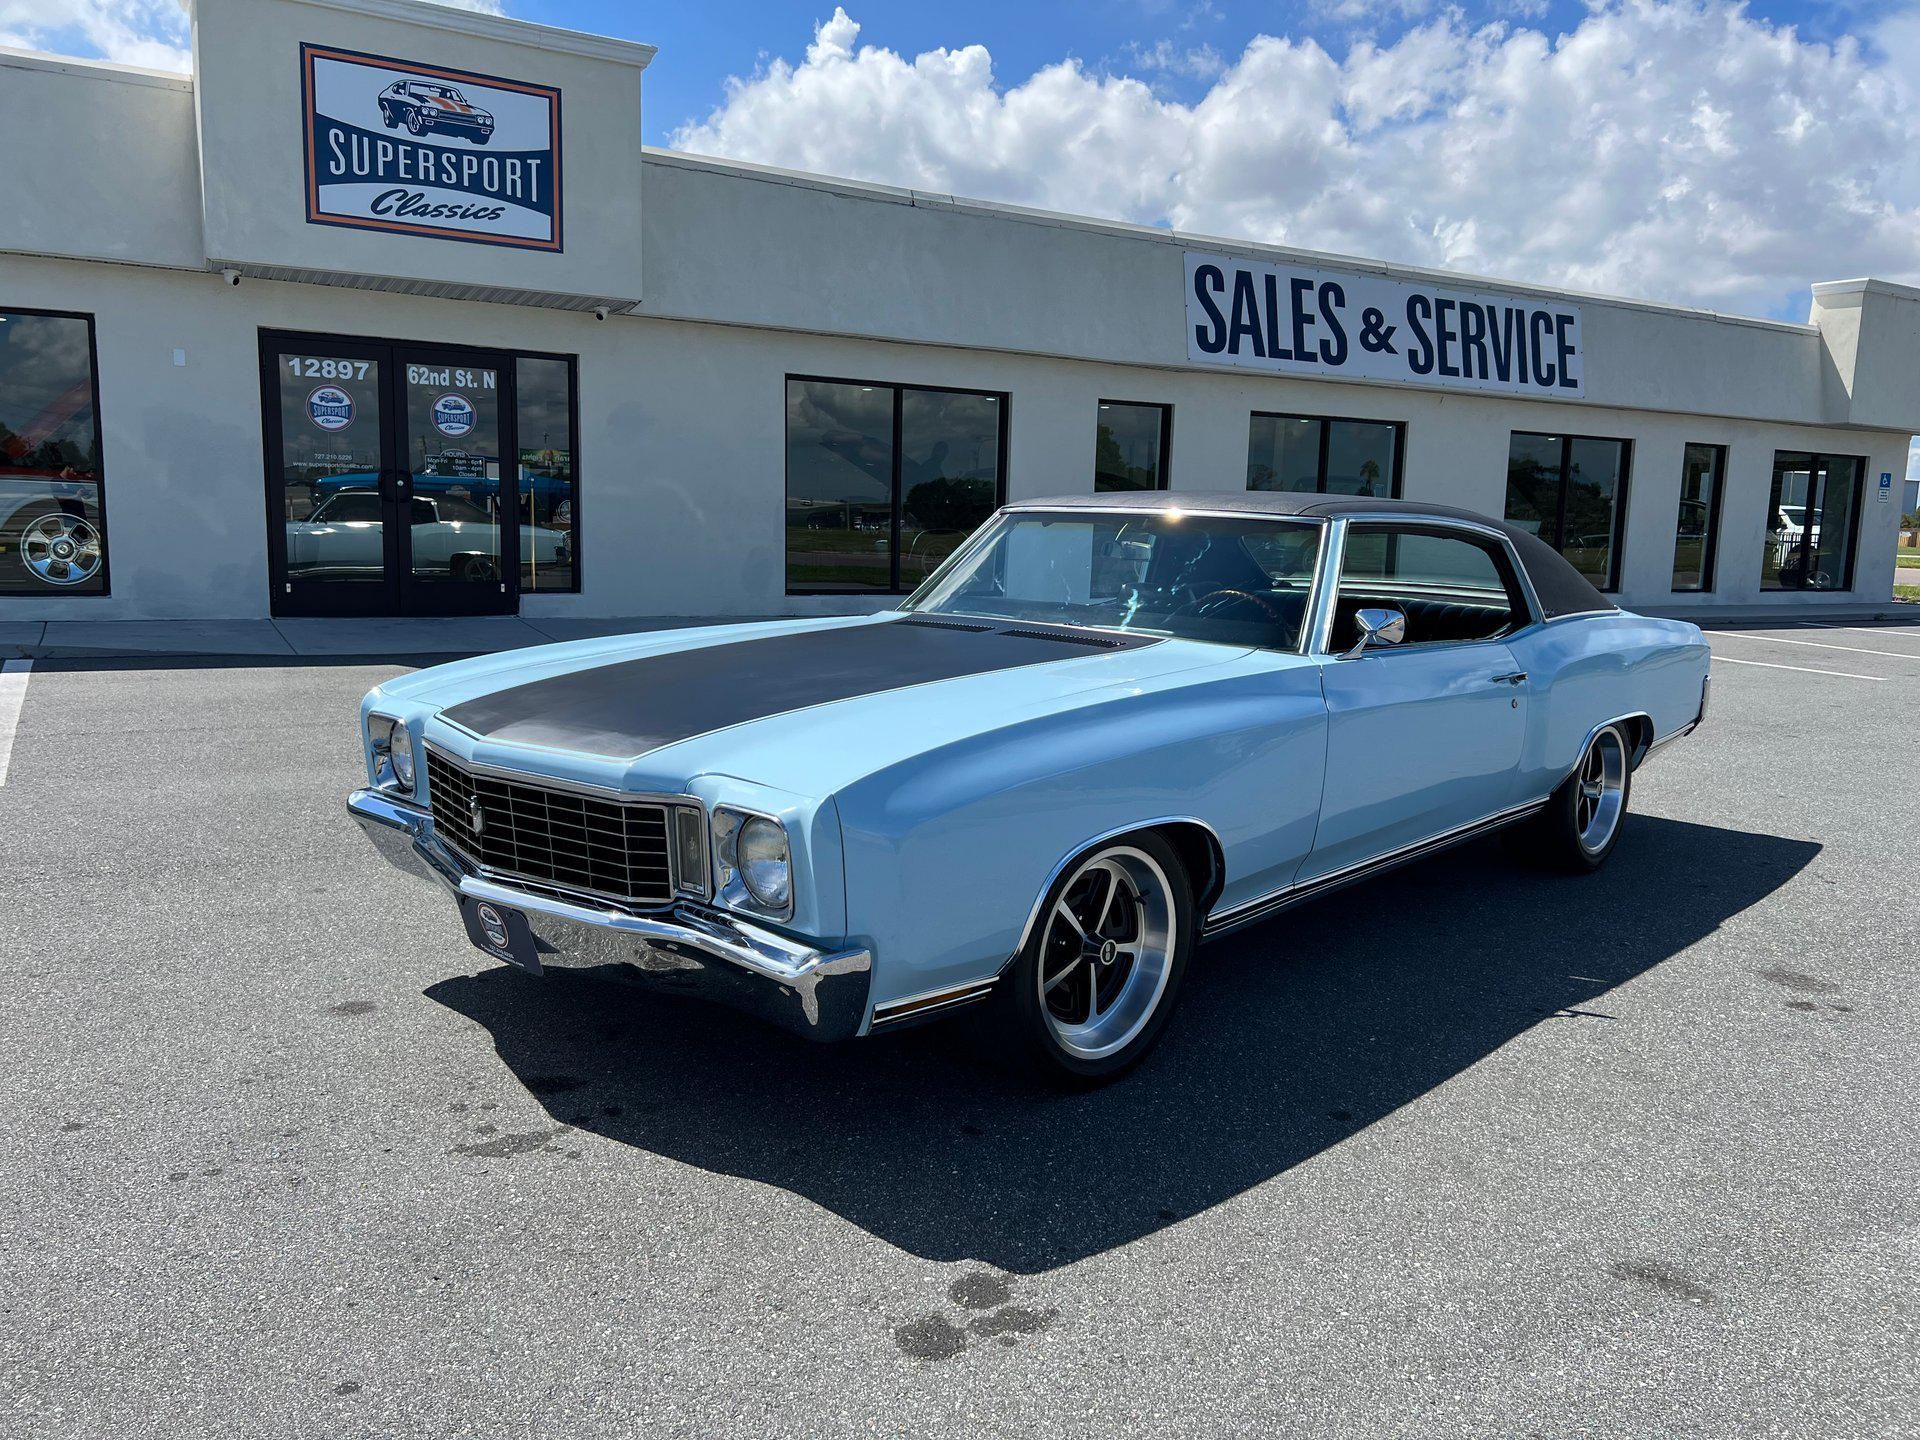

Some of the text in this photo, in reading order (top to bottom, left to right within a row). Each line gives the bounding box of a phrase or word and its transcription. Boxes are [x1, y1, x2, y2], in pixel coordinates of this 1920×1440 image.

[328, 128, 541, 203] SUPERSPORT
[370, 188, 505, 220] Classics
[1194, 264, 1579, 389] SALES & SERVICE
[288, 357, 369, 380] 12897
[408, 366, 495, 389] 62nd St. N
[313, 405, 349, 418] SUPERSPORT
[437, 412, 470, 424] SUPERSPORT
